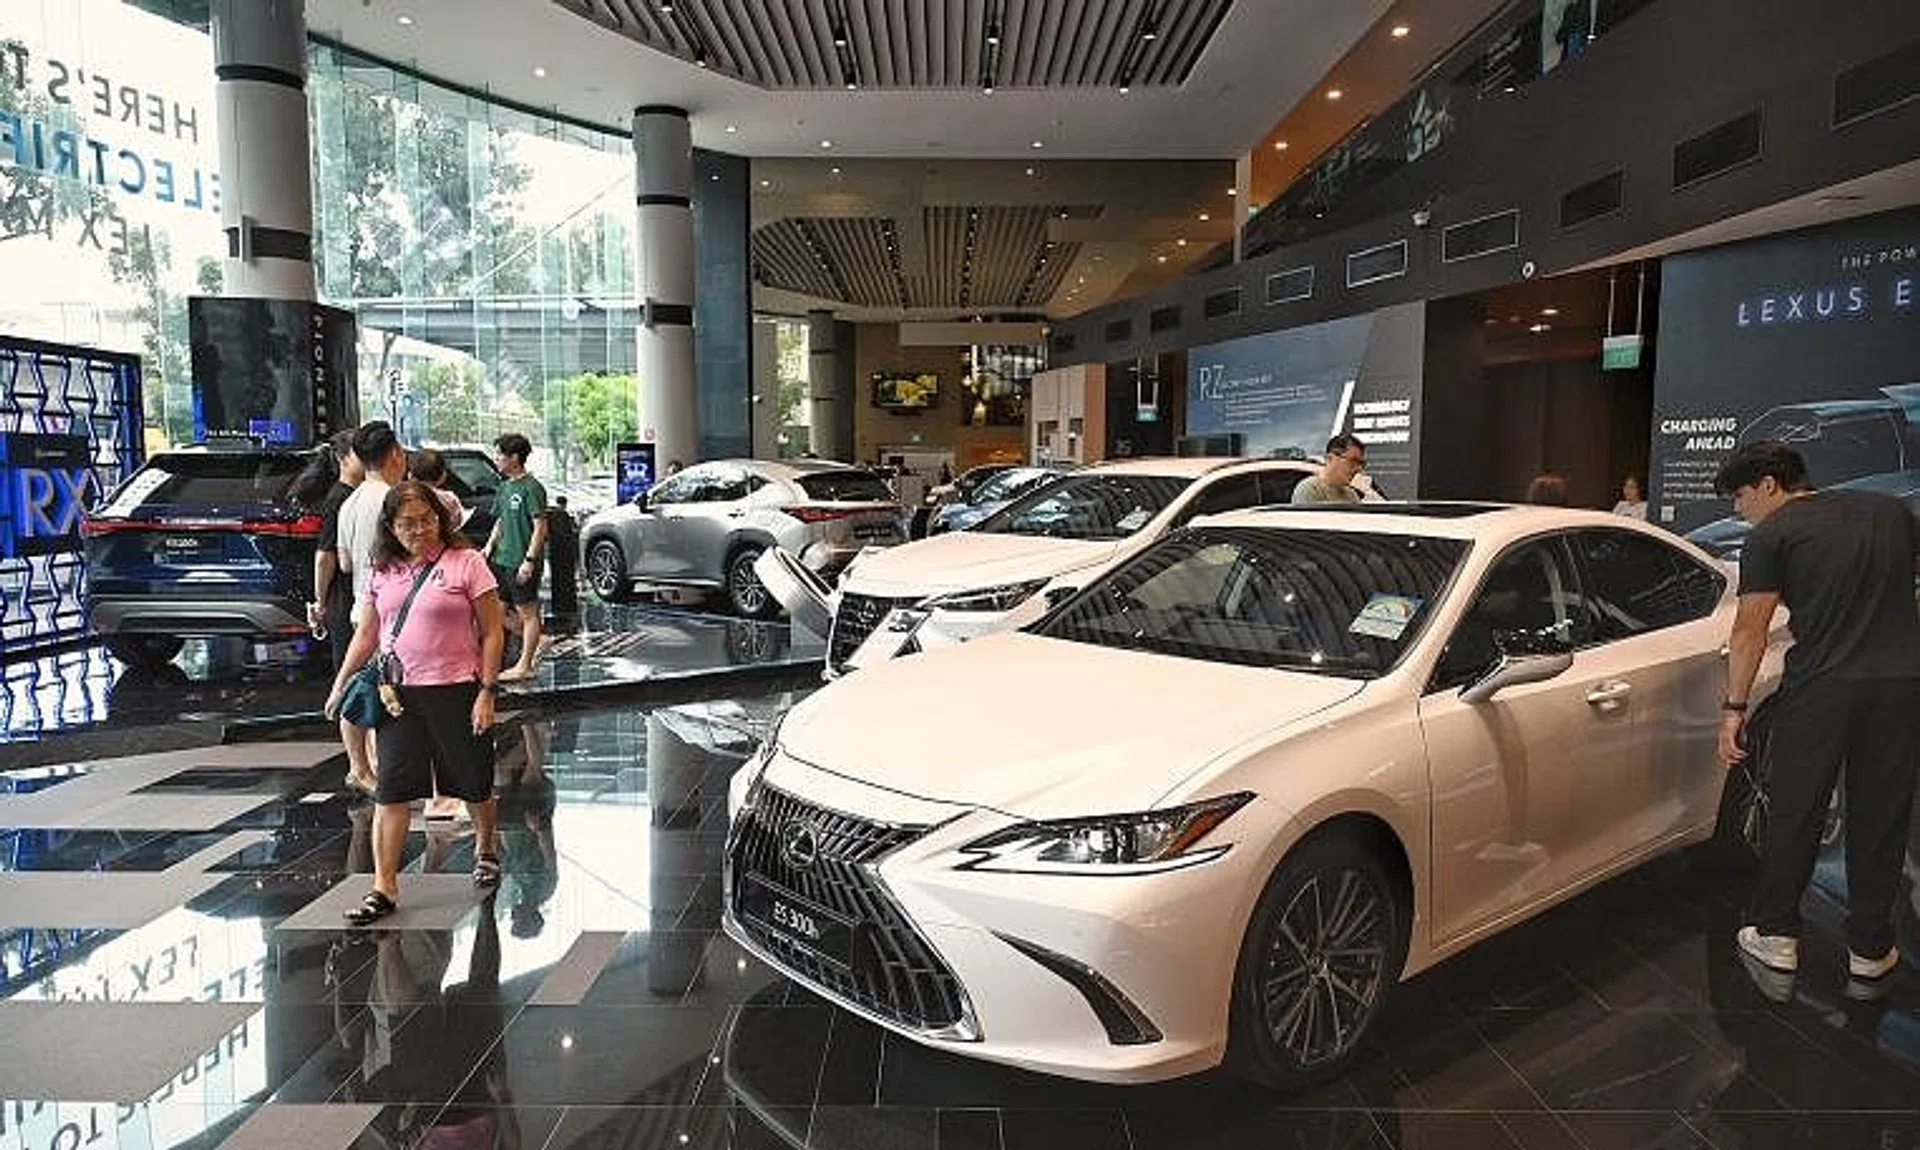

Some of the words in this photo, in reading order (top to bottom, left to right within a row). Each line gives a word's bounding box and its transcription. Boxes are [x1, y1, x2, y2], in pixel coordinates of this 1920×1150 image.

[1738, 286, 1862, 326] LEXUS
[1896, 279, 1911, 306] E
[1661, 417, 1736, 433] CHARGING
[1686, 435, 1735, 450] AHEAD
[21, 466, 91, 537] RX
